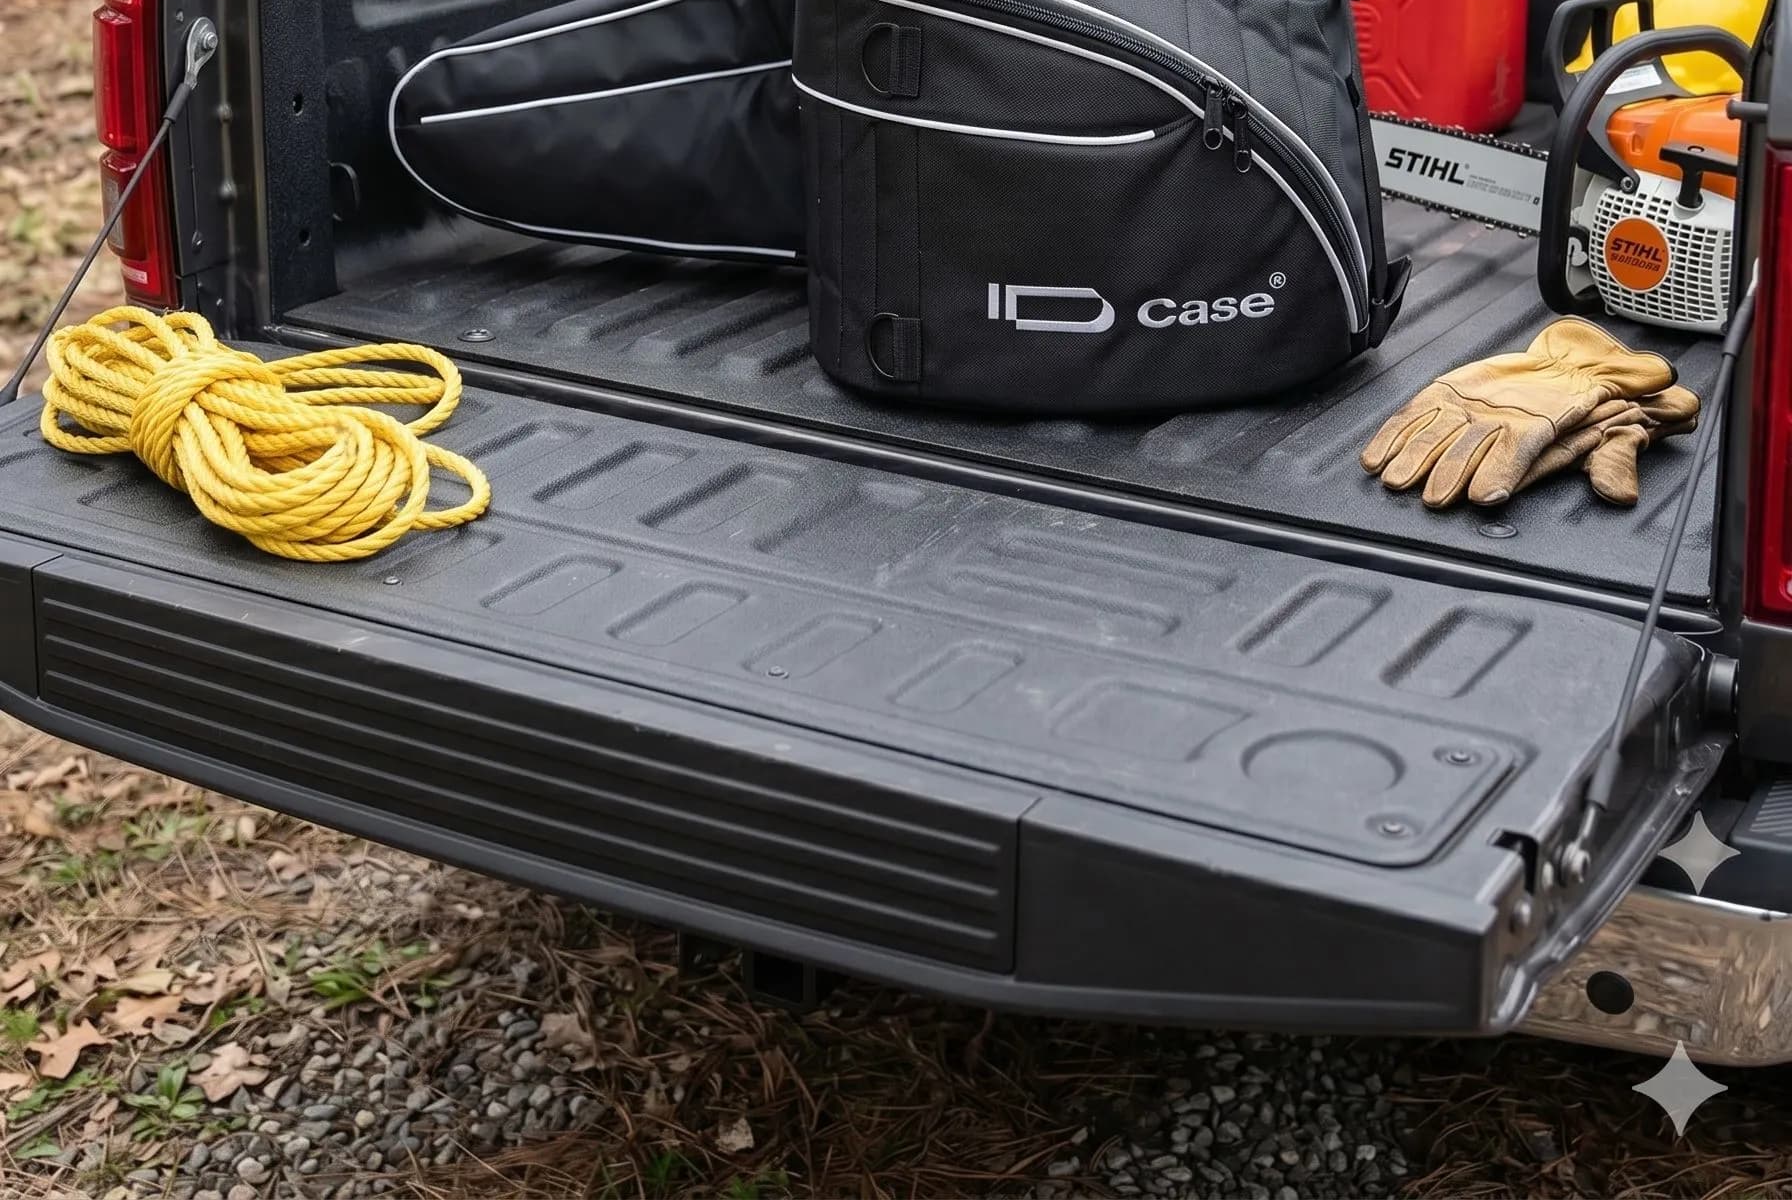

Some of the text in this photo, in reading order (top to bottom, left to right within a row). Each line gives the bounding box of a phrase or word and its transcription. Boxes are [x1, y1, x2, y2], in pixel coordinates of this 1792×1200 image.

[1385, 147, 1465, 186] STIHL
[1610, 237, 1663, 263] STIHL
[987, 282, 1116, 333] ID
